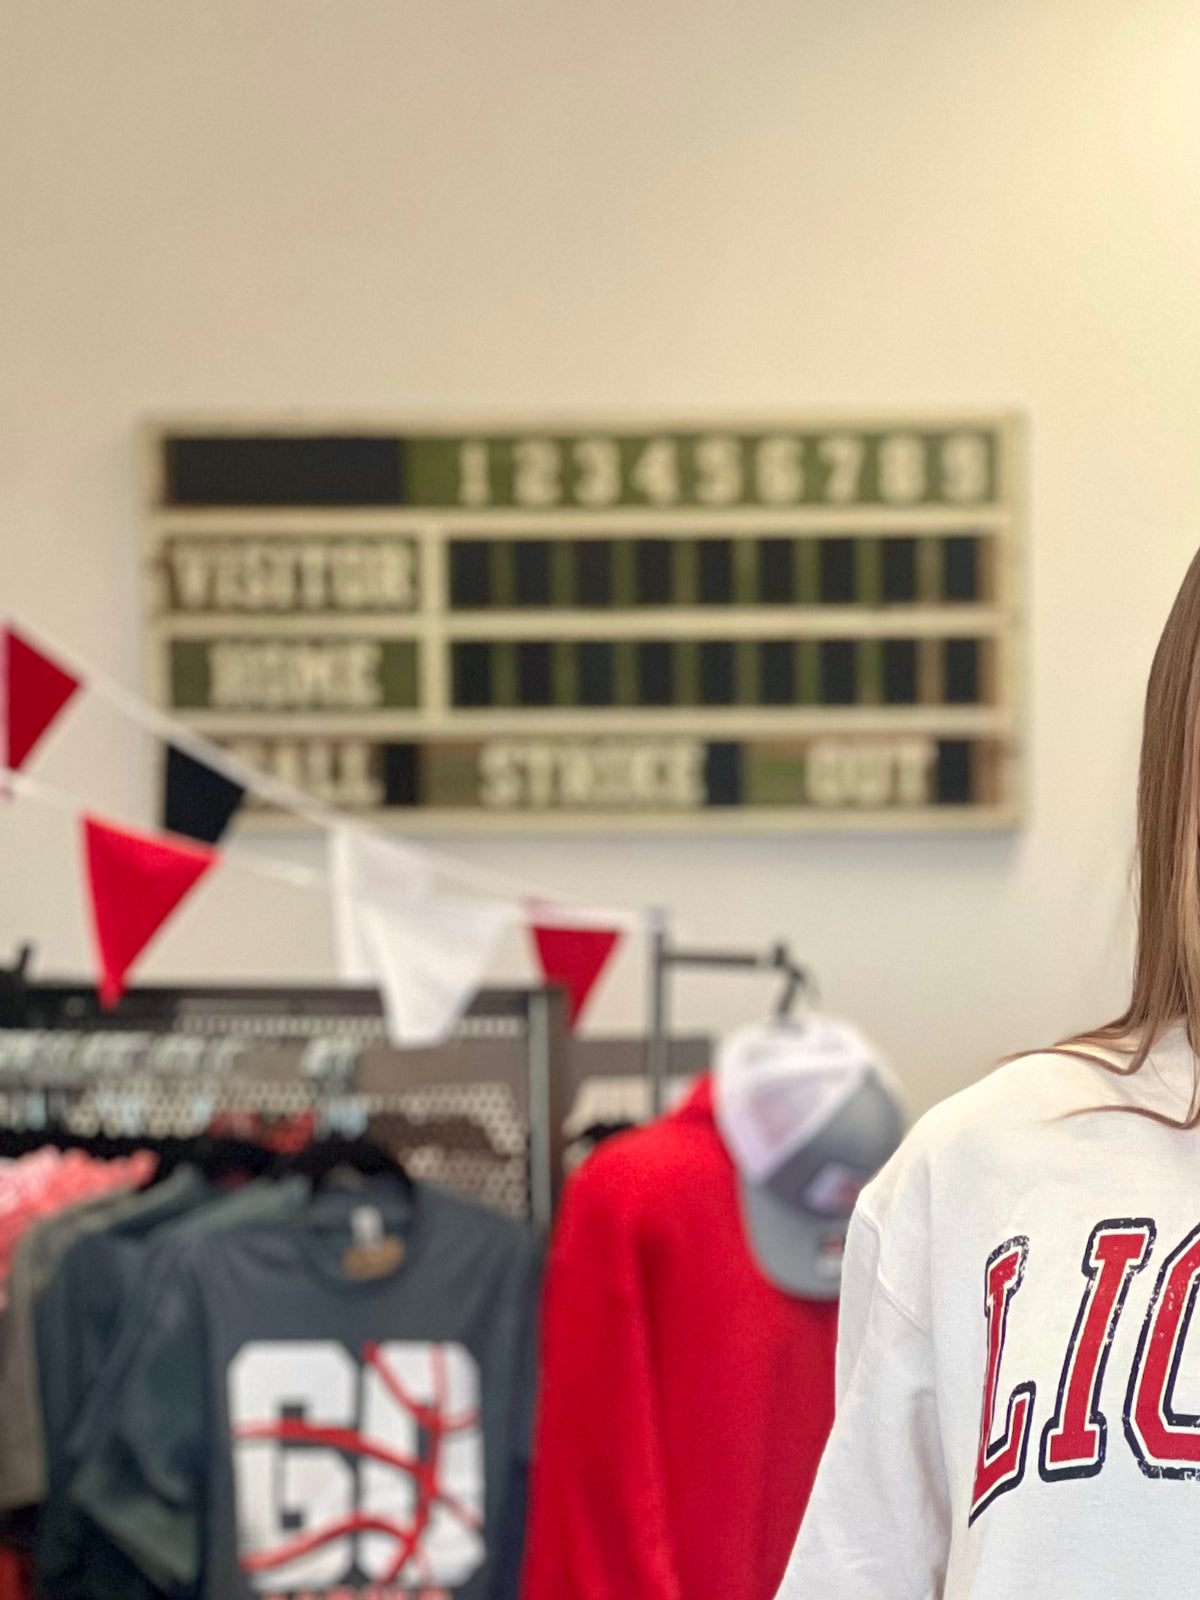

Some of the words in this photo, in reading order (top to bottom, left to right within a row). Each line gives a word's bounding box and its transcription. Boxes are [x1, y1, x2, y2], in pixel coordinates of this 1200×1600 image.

[458, 435, 490, 506] 1
[513, 435, 563, 506] 2
[572, 435, 622, 506] 3
[631, 435, 681, 506] 4
[694, 435, 743, 506] 5
[755, 435, 803, 506] 6
[818, 435, 864, 506] 7
[877, 435, 925, 506] 8
[939, 435, 988, 506] 9
